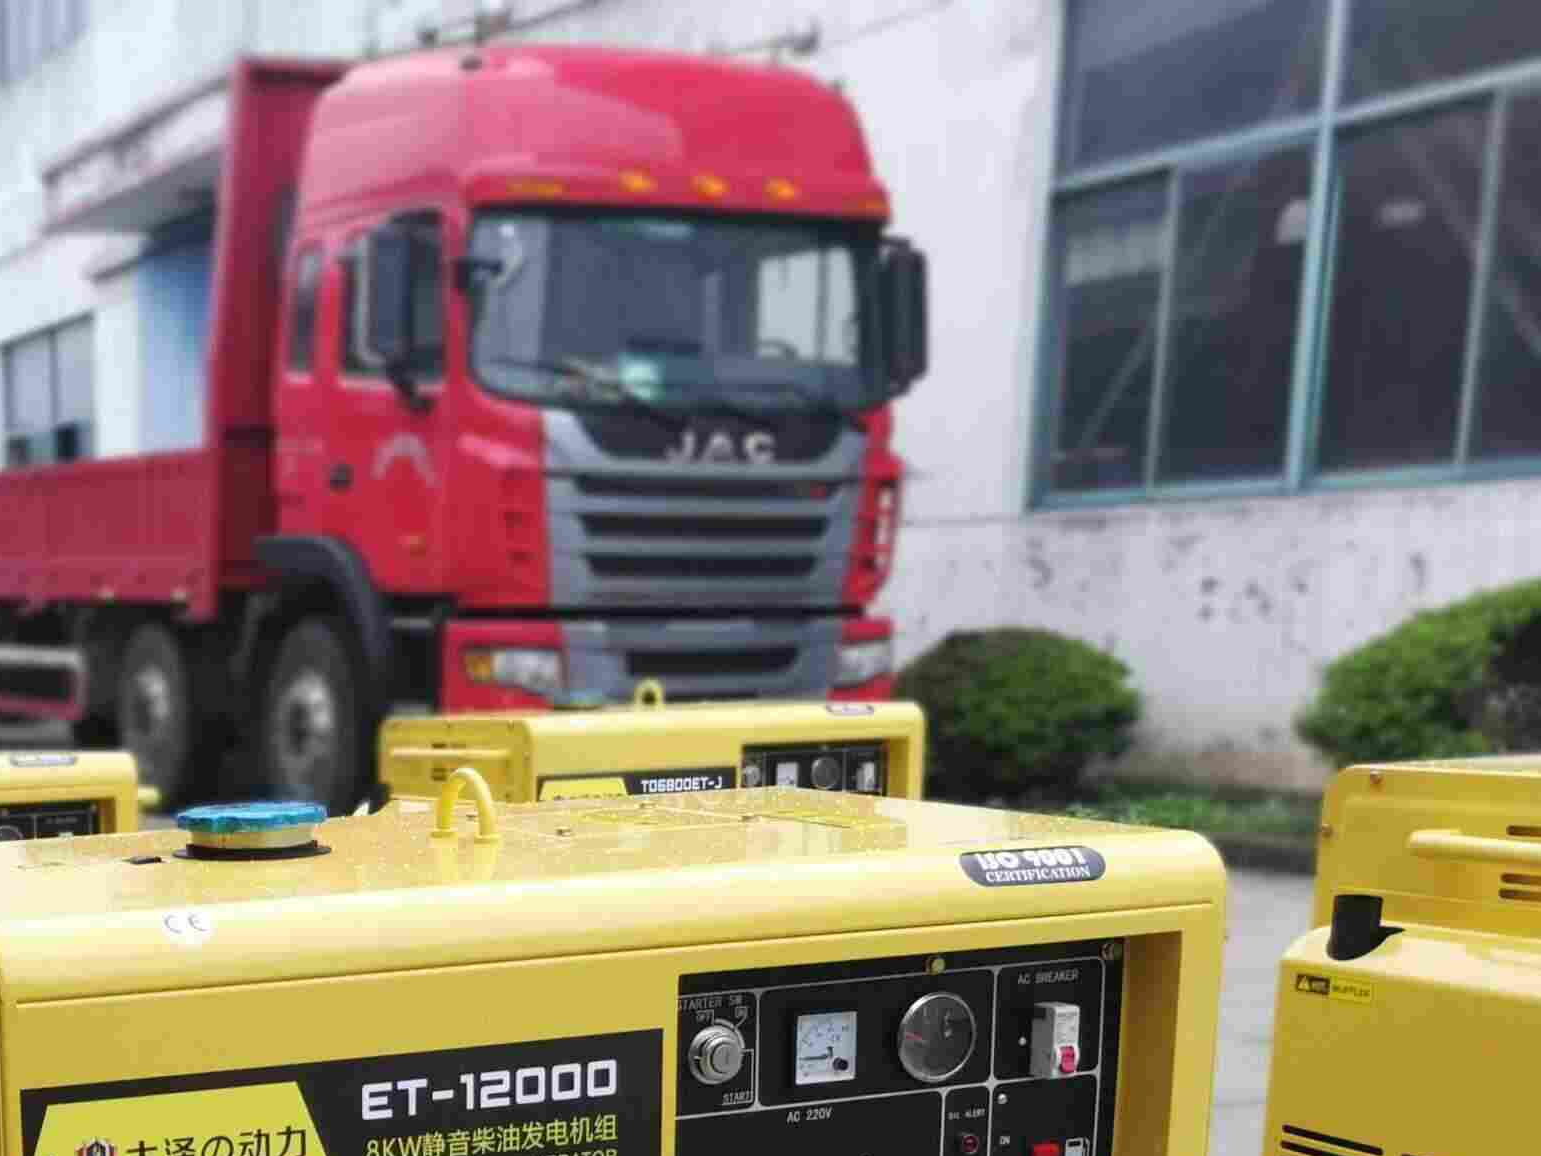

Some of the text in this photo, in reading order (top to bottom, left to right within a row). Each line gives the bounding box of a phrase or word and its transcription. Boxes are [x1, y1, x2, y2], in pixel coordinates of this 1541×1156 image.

[664, 430, 776, 464] JAC
[985, 865, 1091, 883] CERTIFICATION
[361, 1059, 618, 1120] ET-12000
[786, 1106, 833, 1124] AC 220V
[999, 1135, 1010, 1145] ON
